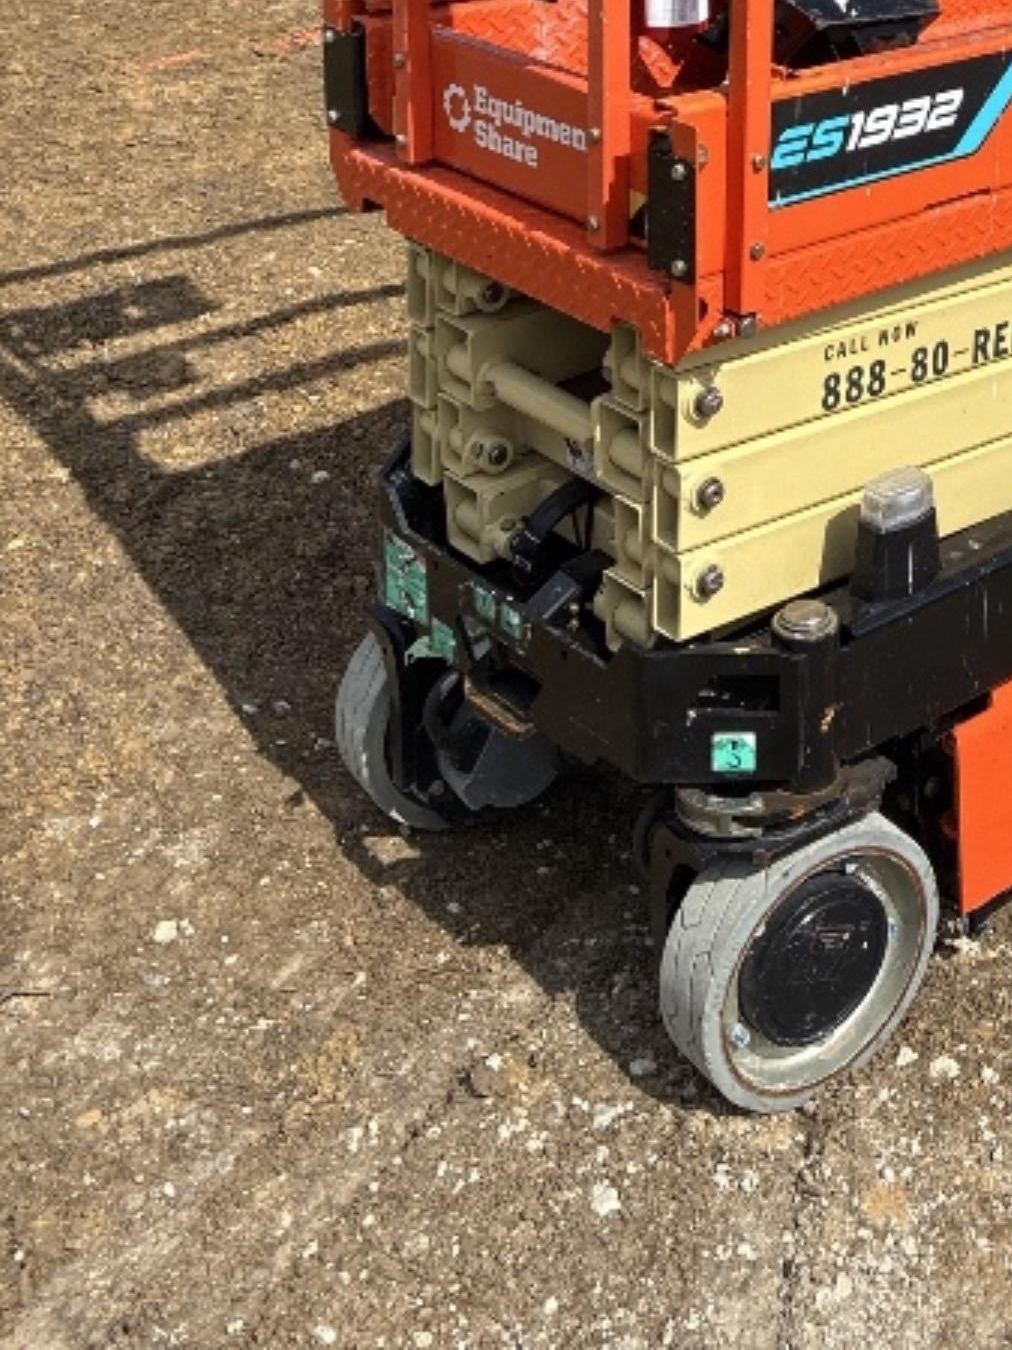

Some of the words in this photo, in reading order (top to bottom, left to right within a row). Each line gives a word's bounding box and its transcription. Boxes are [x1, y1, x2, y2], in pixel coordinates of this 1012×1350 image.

[473, 84, 587, 152] Equipmen
[473, 118, 539, 169] Share
[771, 87, 965, 170] ES1932
[824, 336, 868, 362] CALL
[878, 320, 919, 346] NOW
